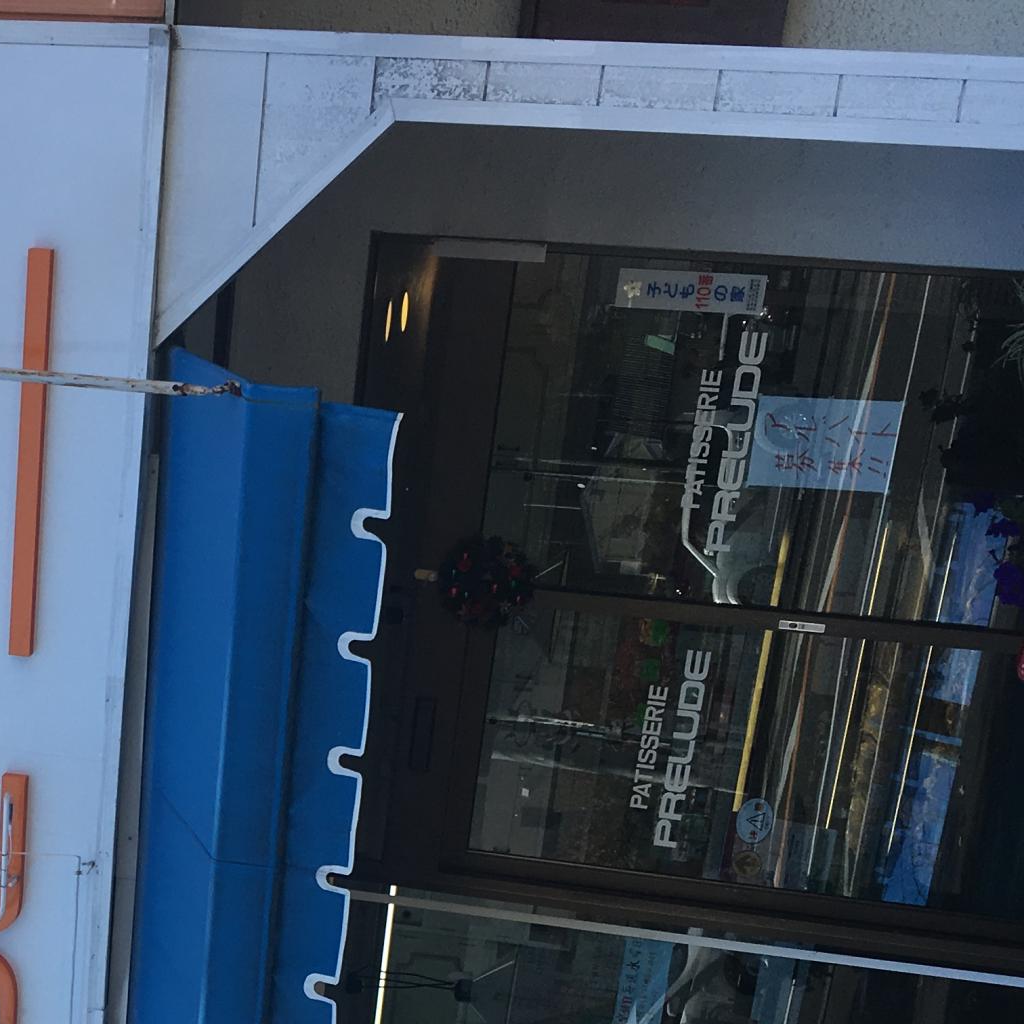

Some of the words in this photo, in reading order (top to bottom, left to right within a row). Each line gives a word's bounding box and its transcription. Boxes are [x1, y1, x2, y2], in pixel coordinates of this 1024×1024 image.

[680, 368, 723, 509] PATISSERIE
[705, 330, 769, 552] PRELUDE
[763, 411, 897, 448] アルバイト
[629, 684, 669, 810] PATISSERIE
[653, 649, 712, 848] PRELUDE
